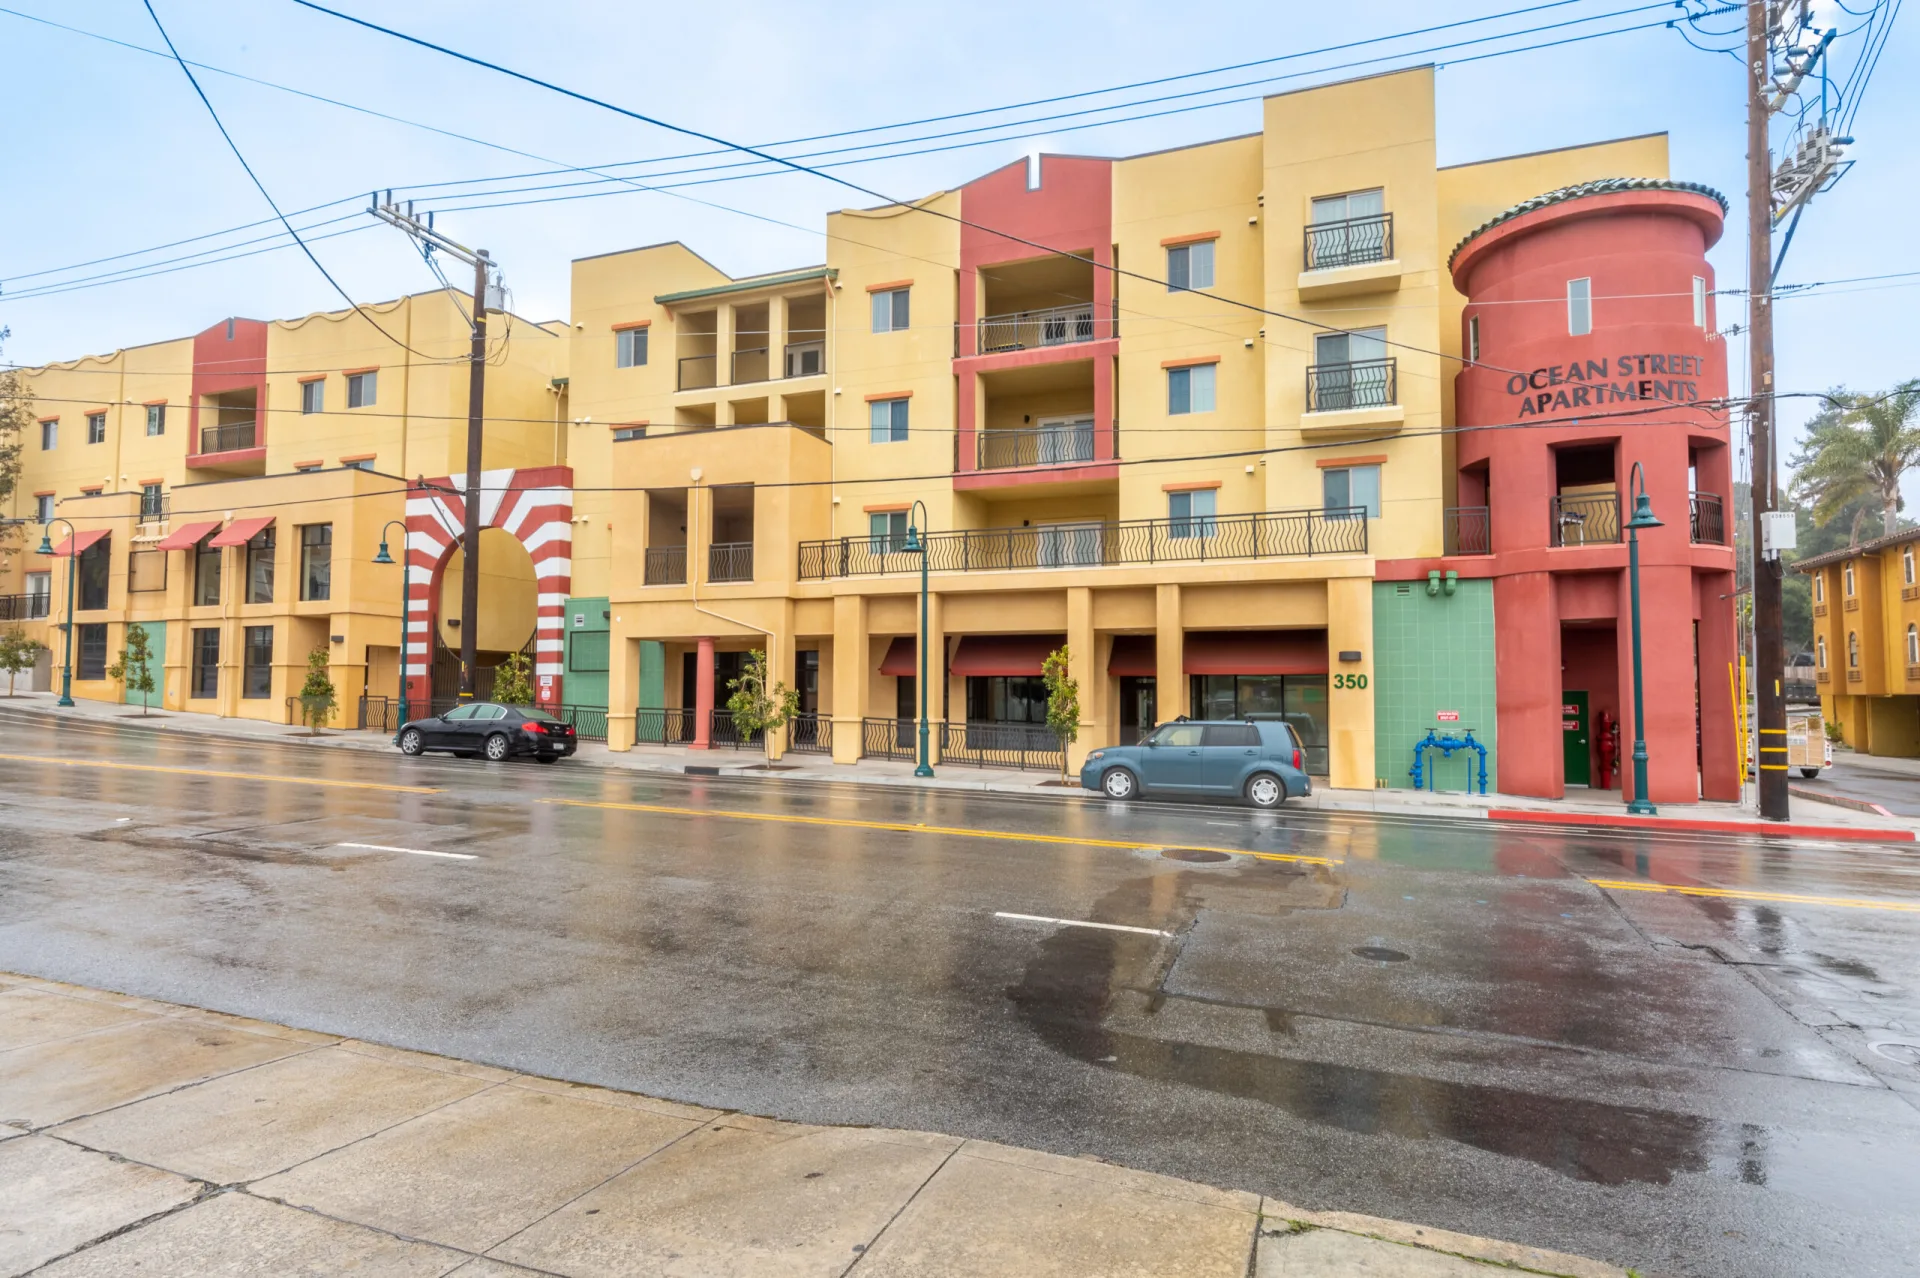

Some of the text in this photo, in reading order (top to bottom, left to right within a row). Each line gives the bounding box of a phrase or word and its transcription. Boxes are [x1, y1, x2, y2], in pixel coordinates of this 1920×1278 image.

[1507, 354, 1704, 395] OCEAN STREET
[1518, 380, 1698, 417] APARTMENTS
[1333, 673, 1368, 690] 350
